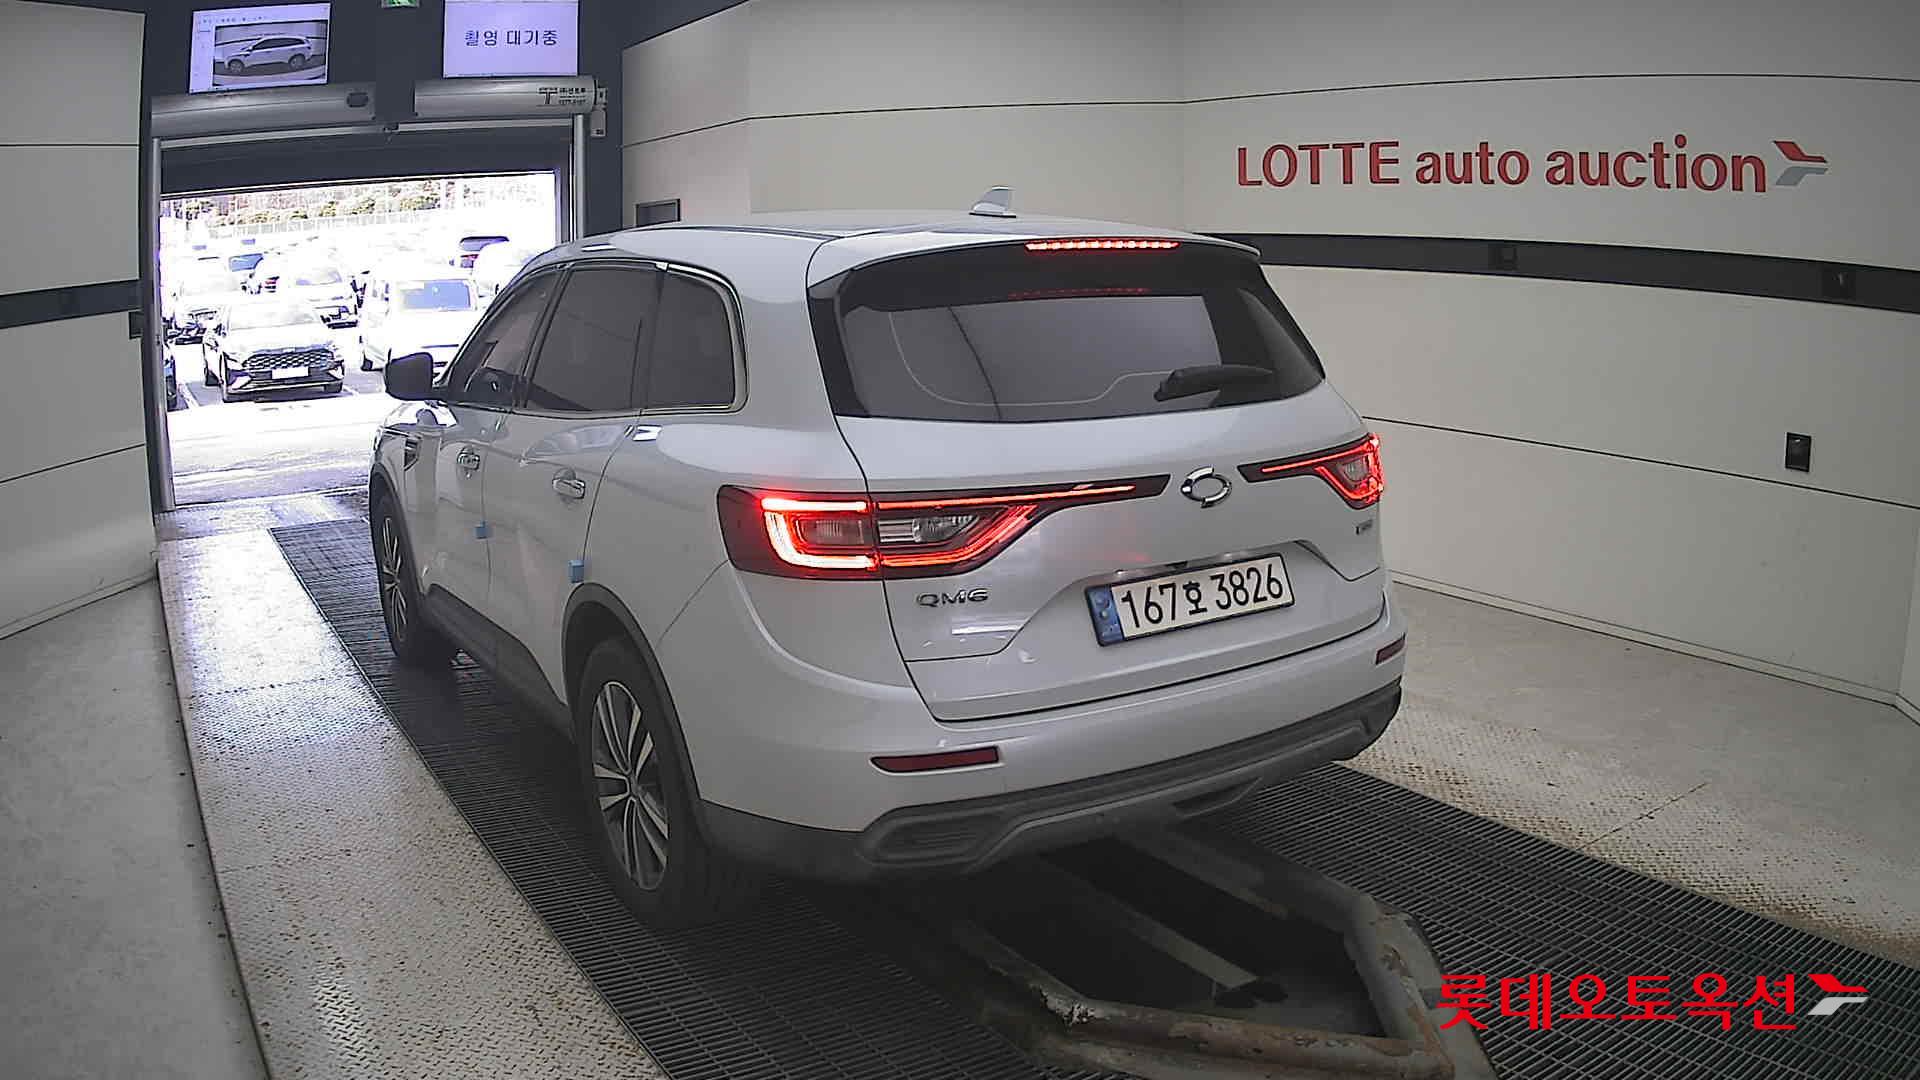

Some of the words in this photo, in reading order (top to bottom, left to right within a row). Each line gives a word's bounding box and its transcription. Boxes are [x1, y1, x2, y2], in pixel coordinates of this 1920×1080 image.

[506, 30, 559, 46] 대기중
[1237, 141, 1399, 187] LOTTE
[1415, 140, 1530, 186] auto
[1545, 134, 1766, 192] auction
[1121, 580, 1207, 628] 167호
[1210, 563, 1283, 610] 3826
